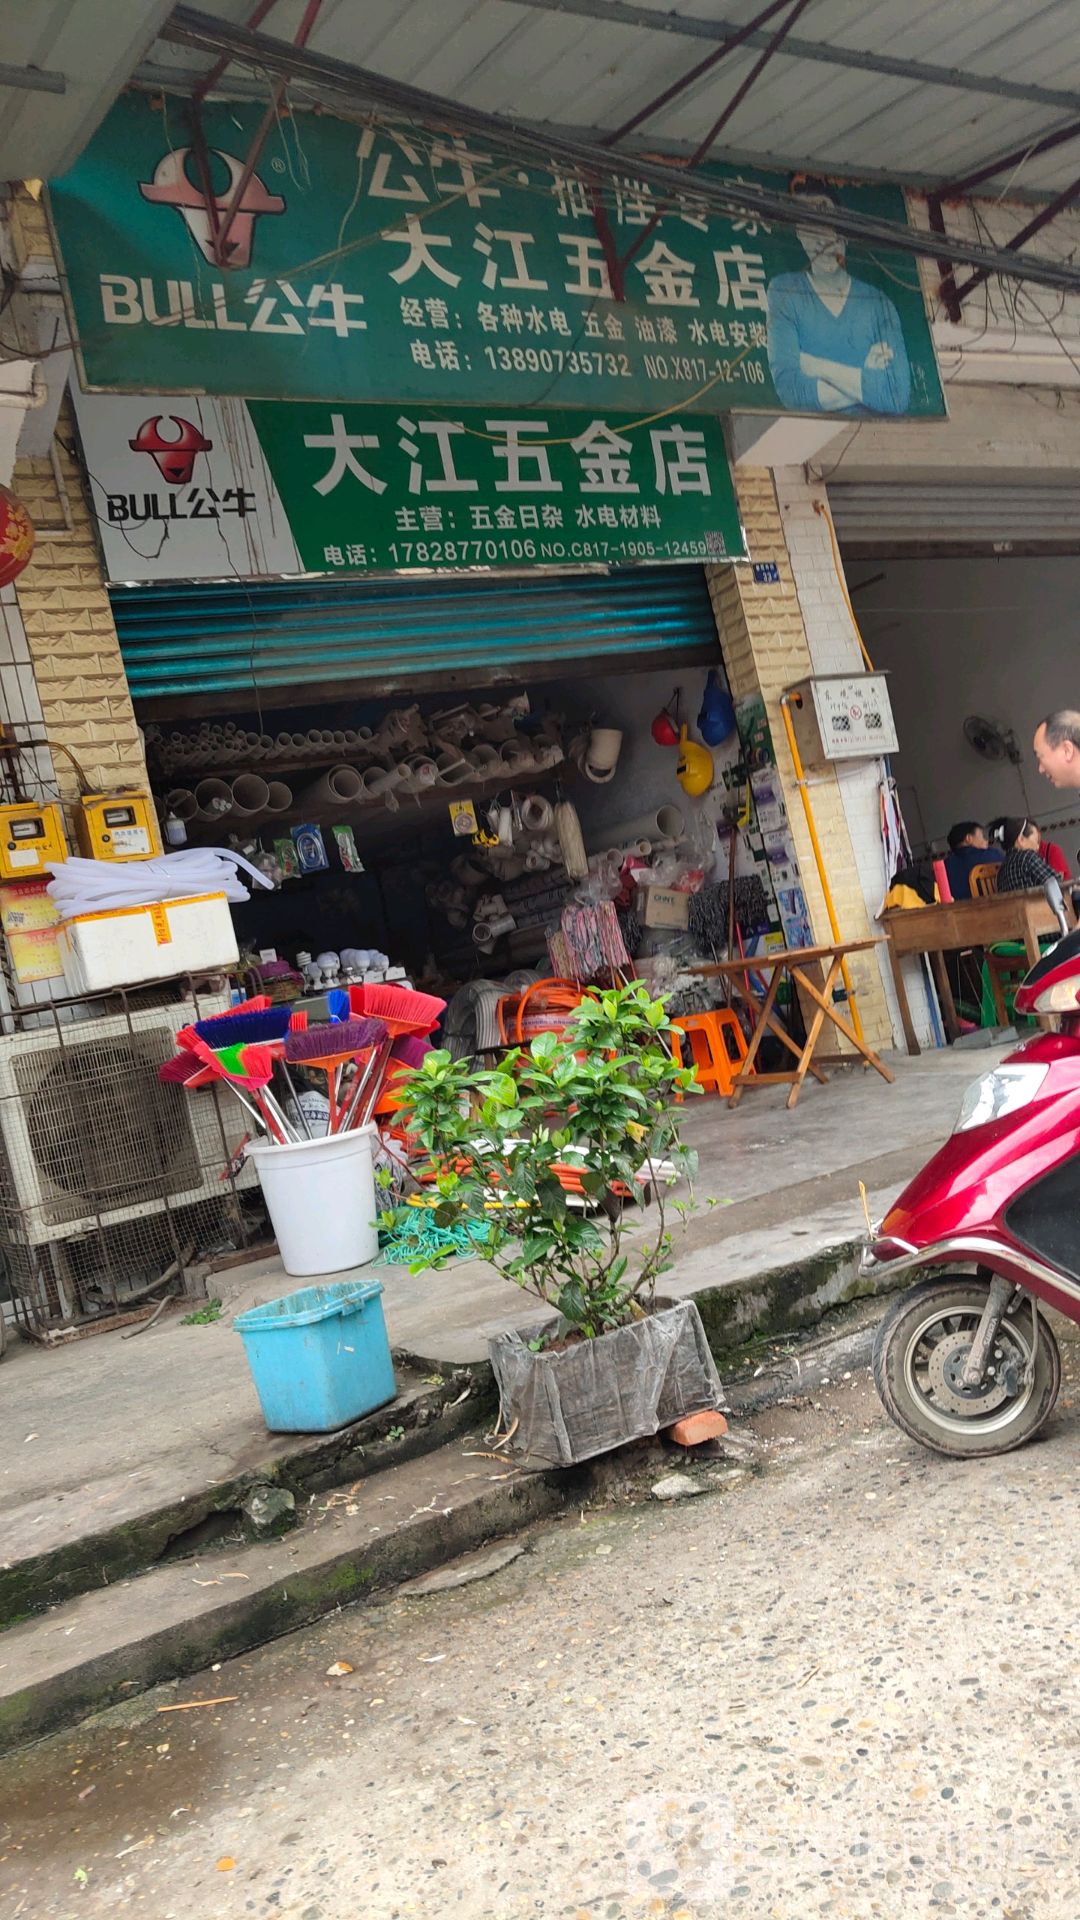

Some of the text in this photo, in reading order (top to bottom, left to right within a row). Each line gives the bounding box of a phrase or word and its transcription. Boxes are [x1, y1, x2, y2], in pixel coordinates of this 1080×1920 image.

[381, 212, 769, 310] 大江五金店
[581, 311, 625, 341] 五金
[634, 315, 678, 344] 油漆
[688, 318, 767, 348] 水电安装
[303, 413, 712, 496] 大江五金店
[575, 503, 662, 529] 水电材料
[540, 541, 707, 558] NO.C817-1905-12459
